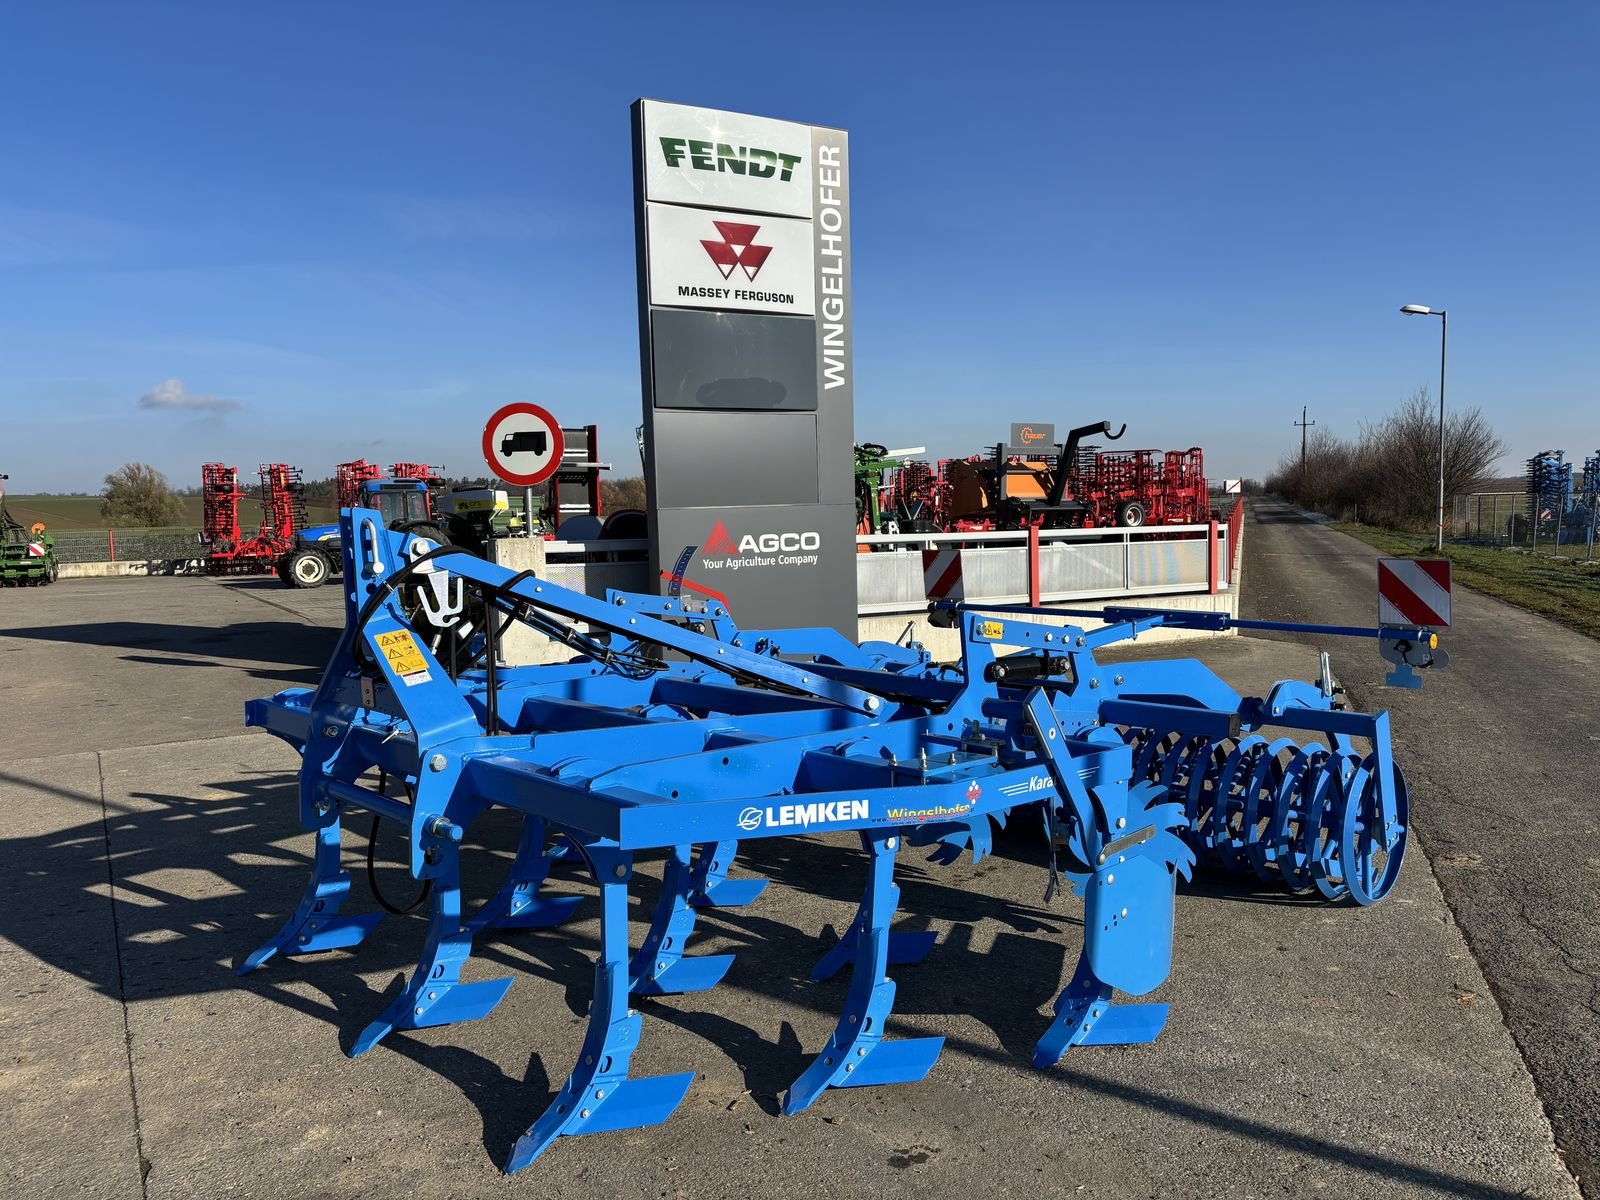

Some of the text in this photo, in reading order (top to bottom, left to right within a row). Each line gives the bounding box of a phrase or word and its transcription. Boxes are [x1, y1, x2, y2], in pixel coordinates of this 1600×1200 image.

[659, 136, 802, 182] FENDT
[819, 145, 845, 390] WINGELHOFER
[678, 286, 794, 304] MASSEY FERGUSON
[738, 532, 820, 553] AGCO
[703, 554, 818, 570] Your Agriculture Company
[766, 799, 869, 829] LEMKEN
